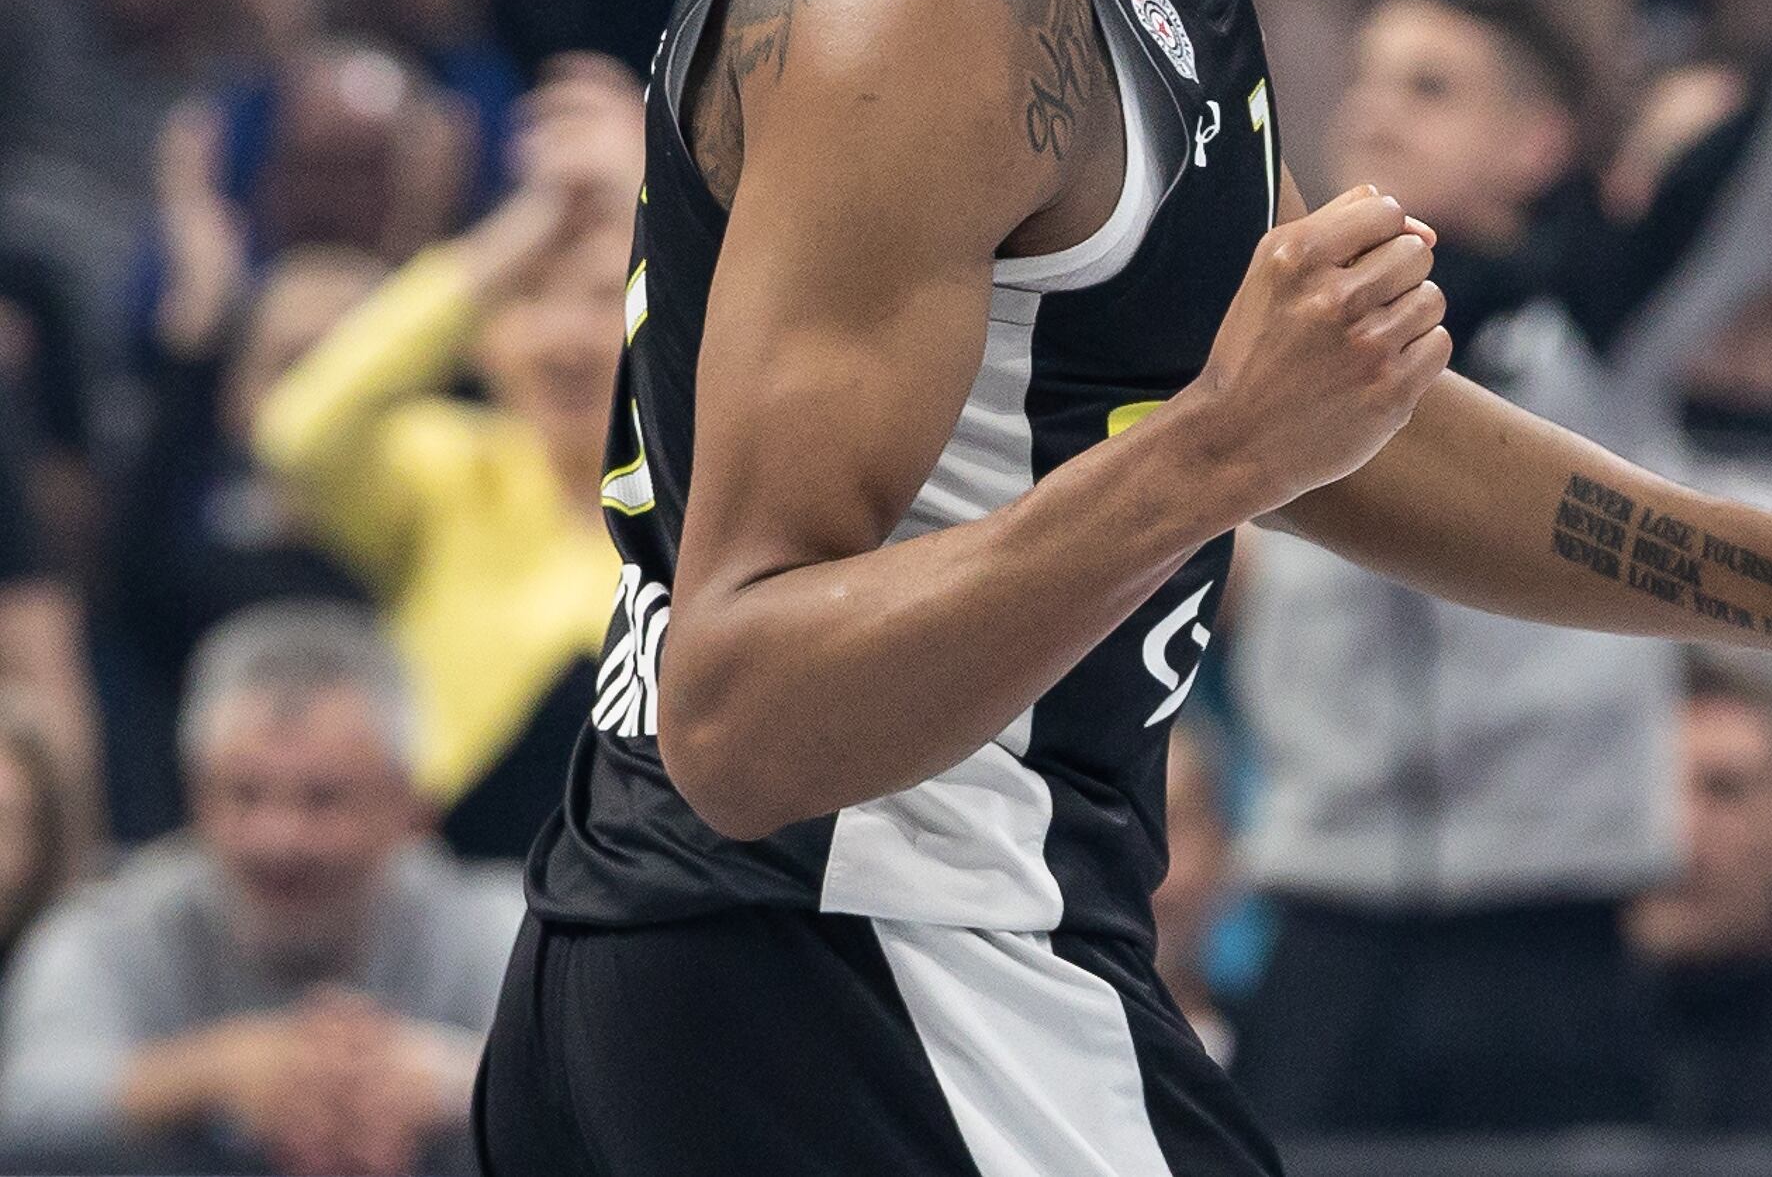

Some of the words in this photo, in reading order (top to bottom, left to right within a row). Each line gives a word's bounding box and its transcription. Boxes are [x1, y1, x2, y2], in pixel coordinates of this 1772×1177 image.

[1555, 498, 1626, 554] NEVER
[1566, 474, 1635, 522] NEVER
[1638, 507, 1697, 552] LOSE
[1551, 526, 1621, 582] NEVER
